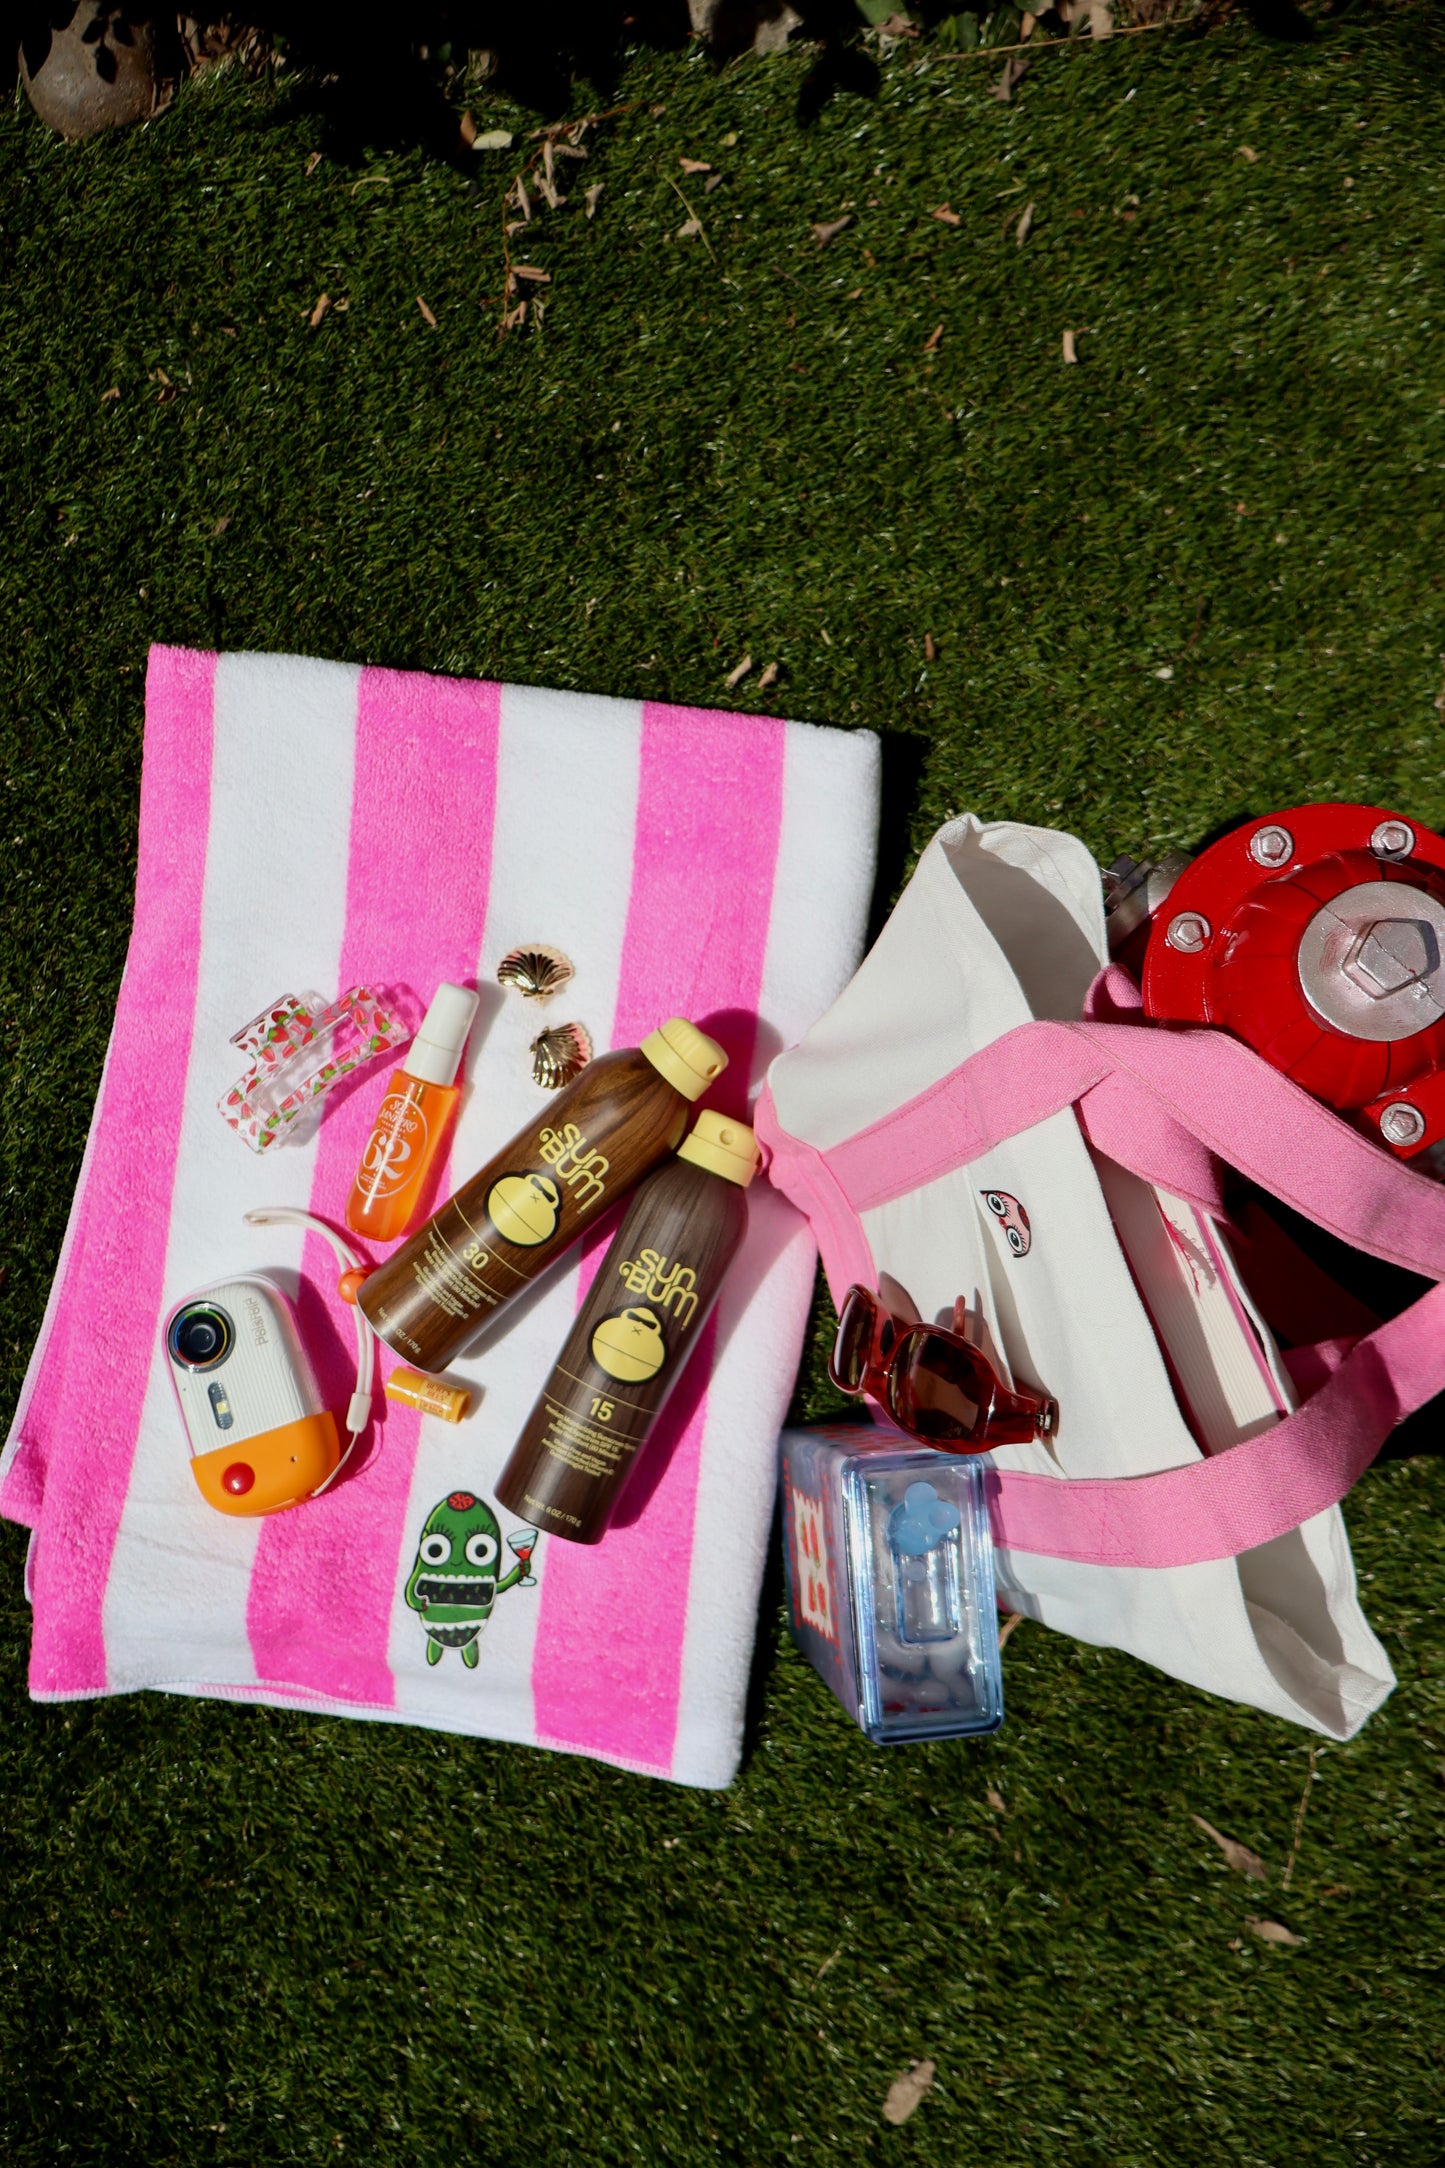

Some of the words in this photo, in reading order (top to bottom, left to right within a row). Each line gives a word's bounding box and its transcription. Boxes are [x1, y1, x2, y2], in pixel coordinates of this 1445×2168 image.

[363, 1128, 411, 1180] 62
[462, 1242, 489, 1269] 30
[590, 1397, 615, 1421] 15
